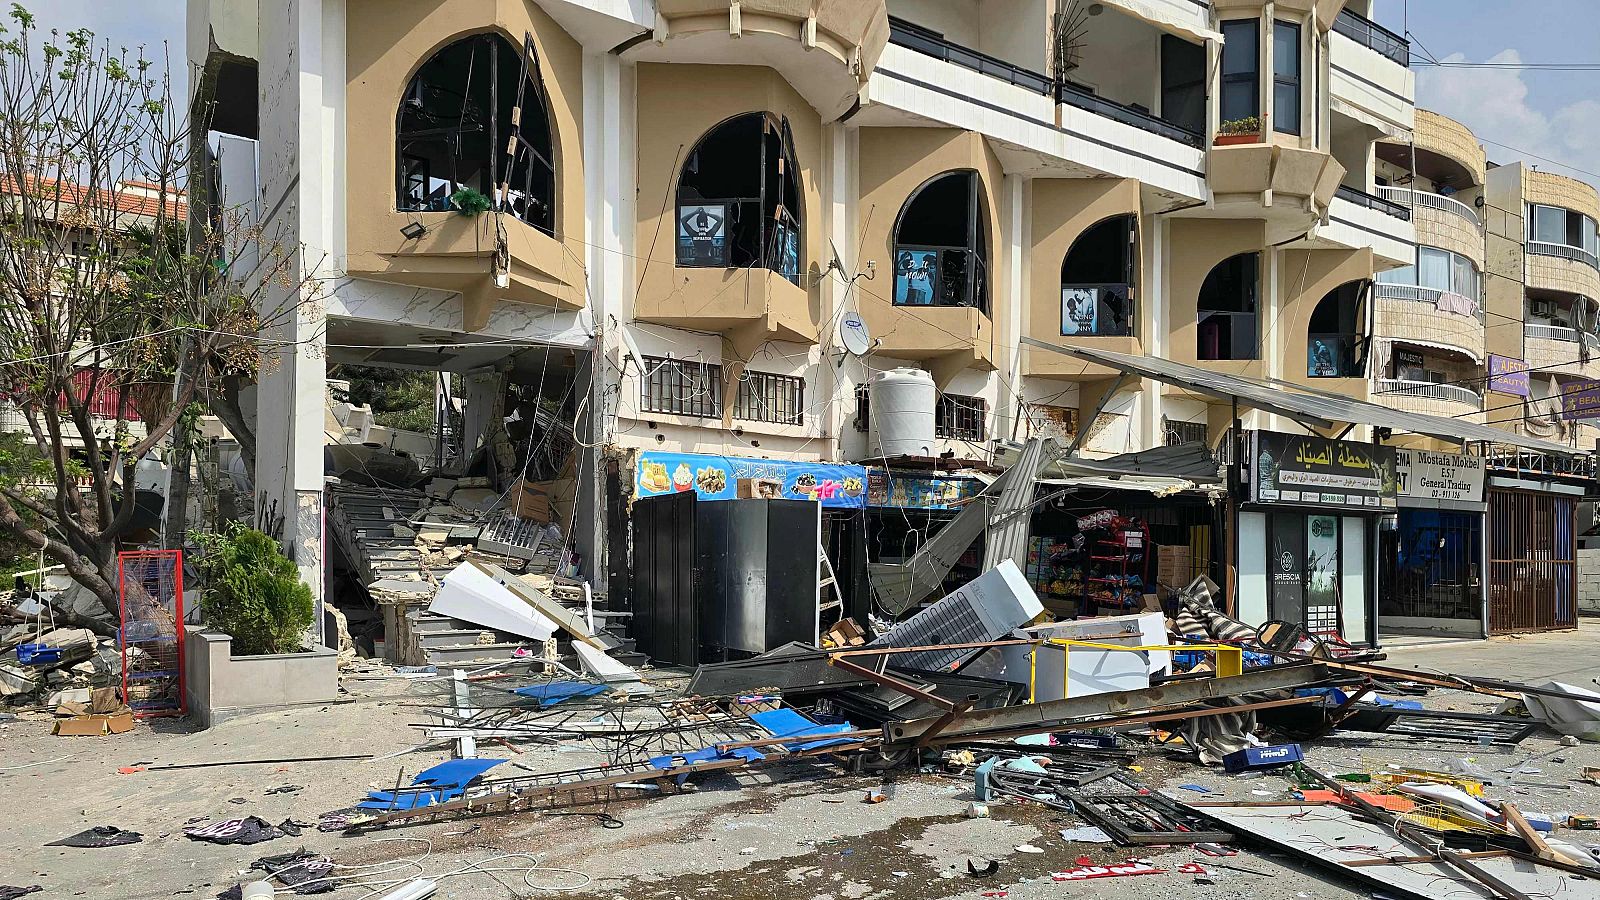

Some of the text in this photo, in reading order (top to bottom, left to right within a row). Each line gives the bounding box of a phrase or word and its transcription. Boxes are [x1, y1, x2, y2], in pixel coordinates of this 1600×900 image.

[1497, 376, 1524, 388] EAUTY
[1418, 452, 1480, 469] Mostafa Mokbel
[1421, 477, 1471, 493] General Trading
